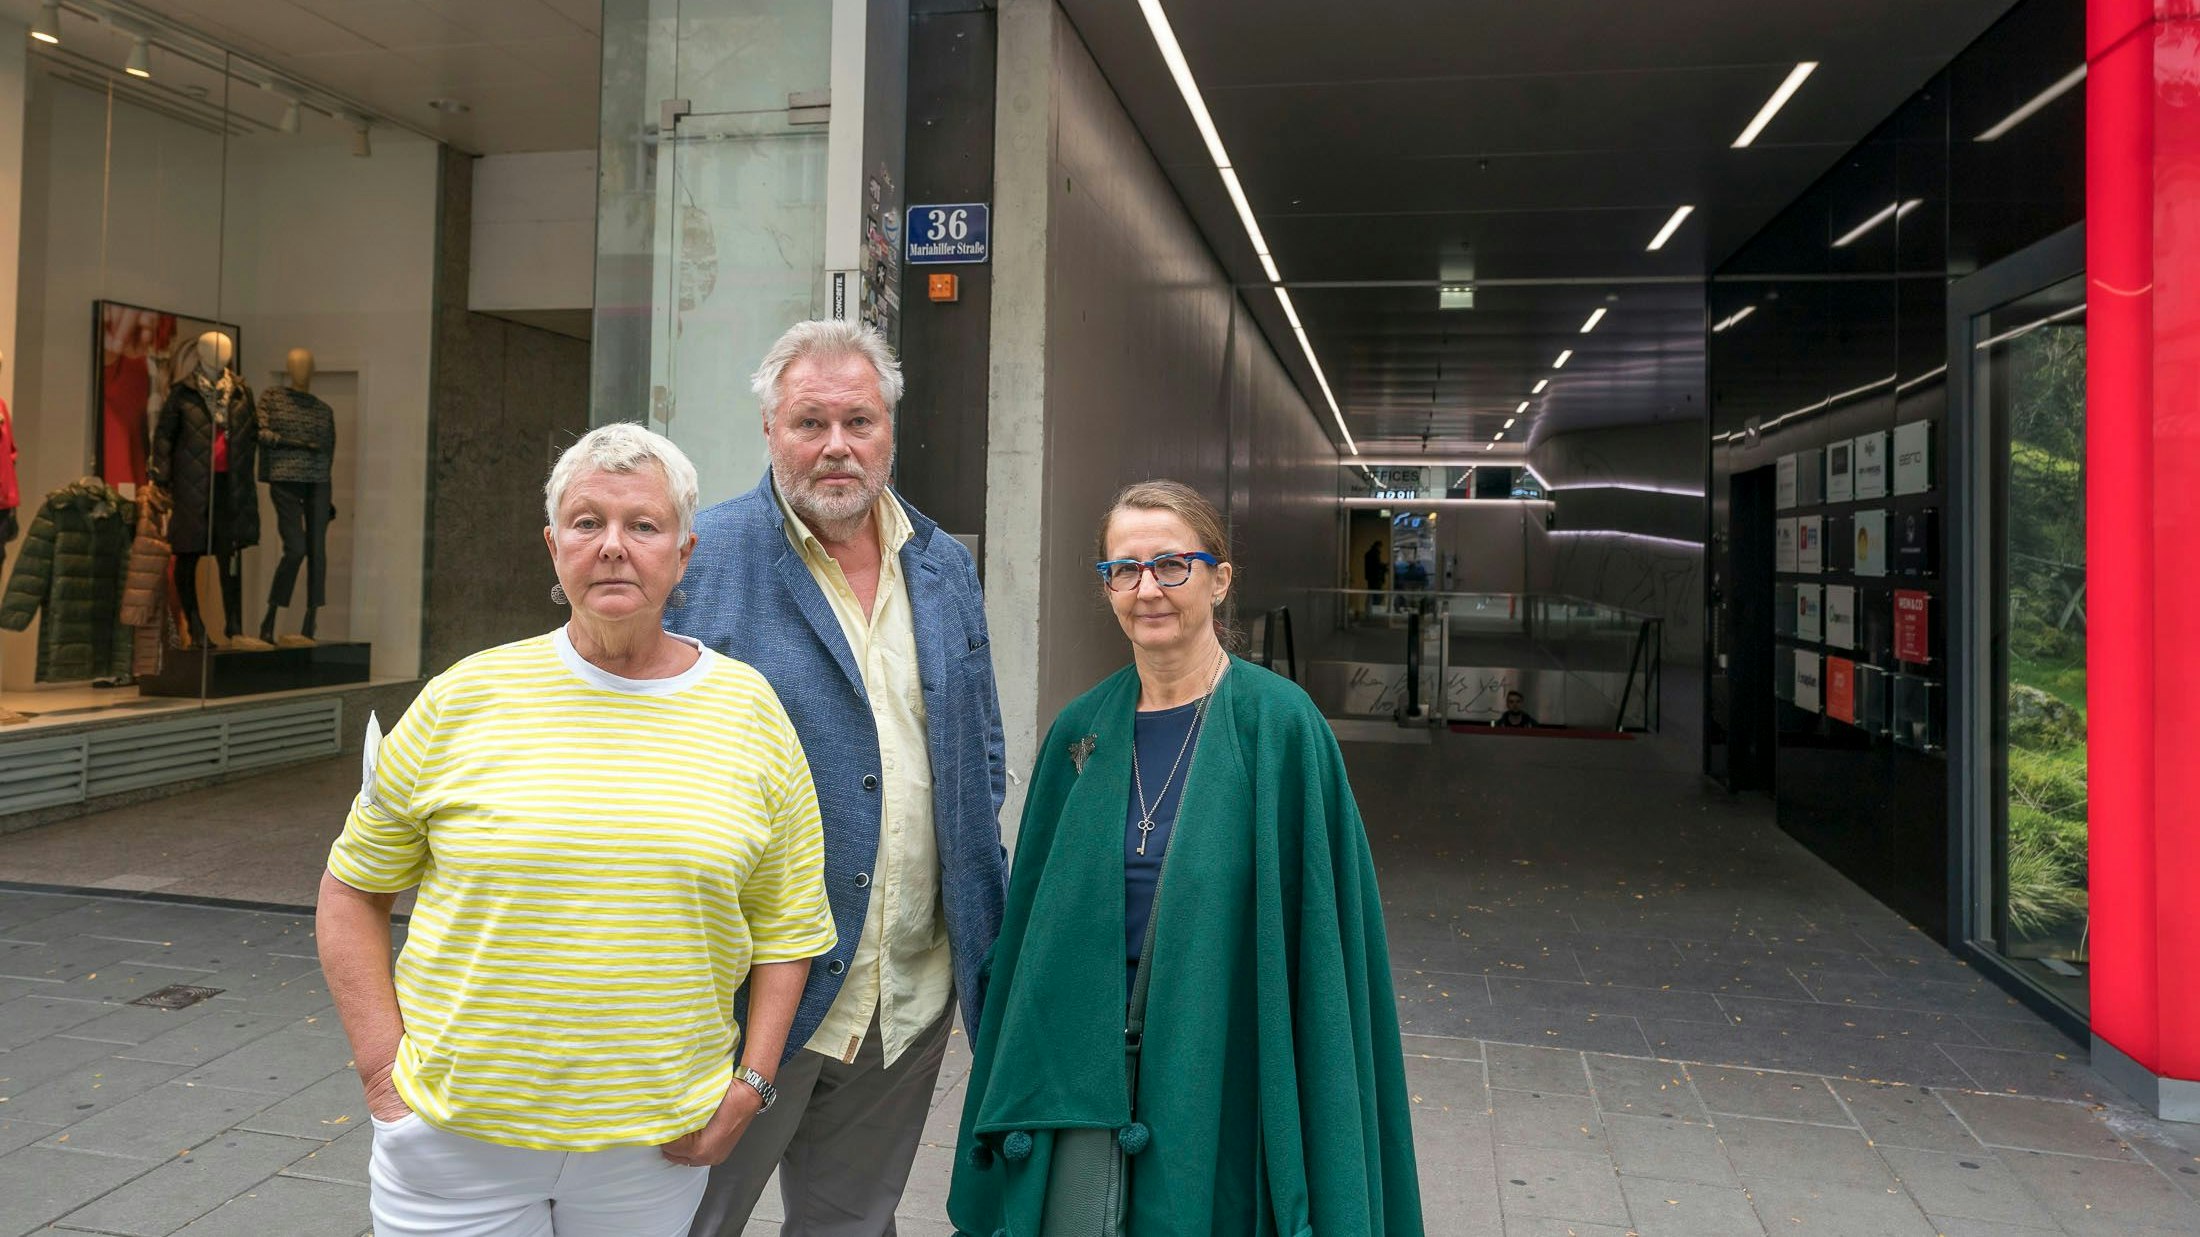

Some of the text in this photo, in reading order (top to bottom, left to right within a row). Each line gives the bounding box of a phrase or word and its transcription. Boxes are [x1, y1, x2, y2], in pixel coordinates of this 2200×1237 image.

[927, 209, 968, 241] 36
[910, 241, 985, 256] Mariahilfer Straße
